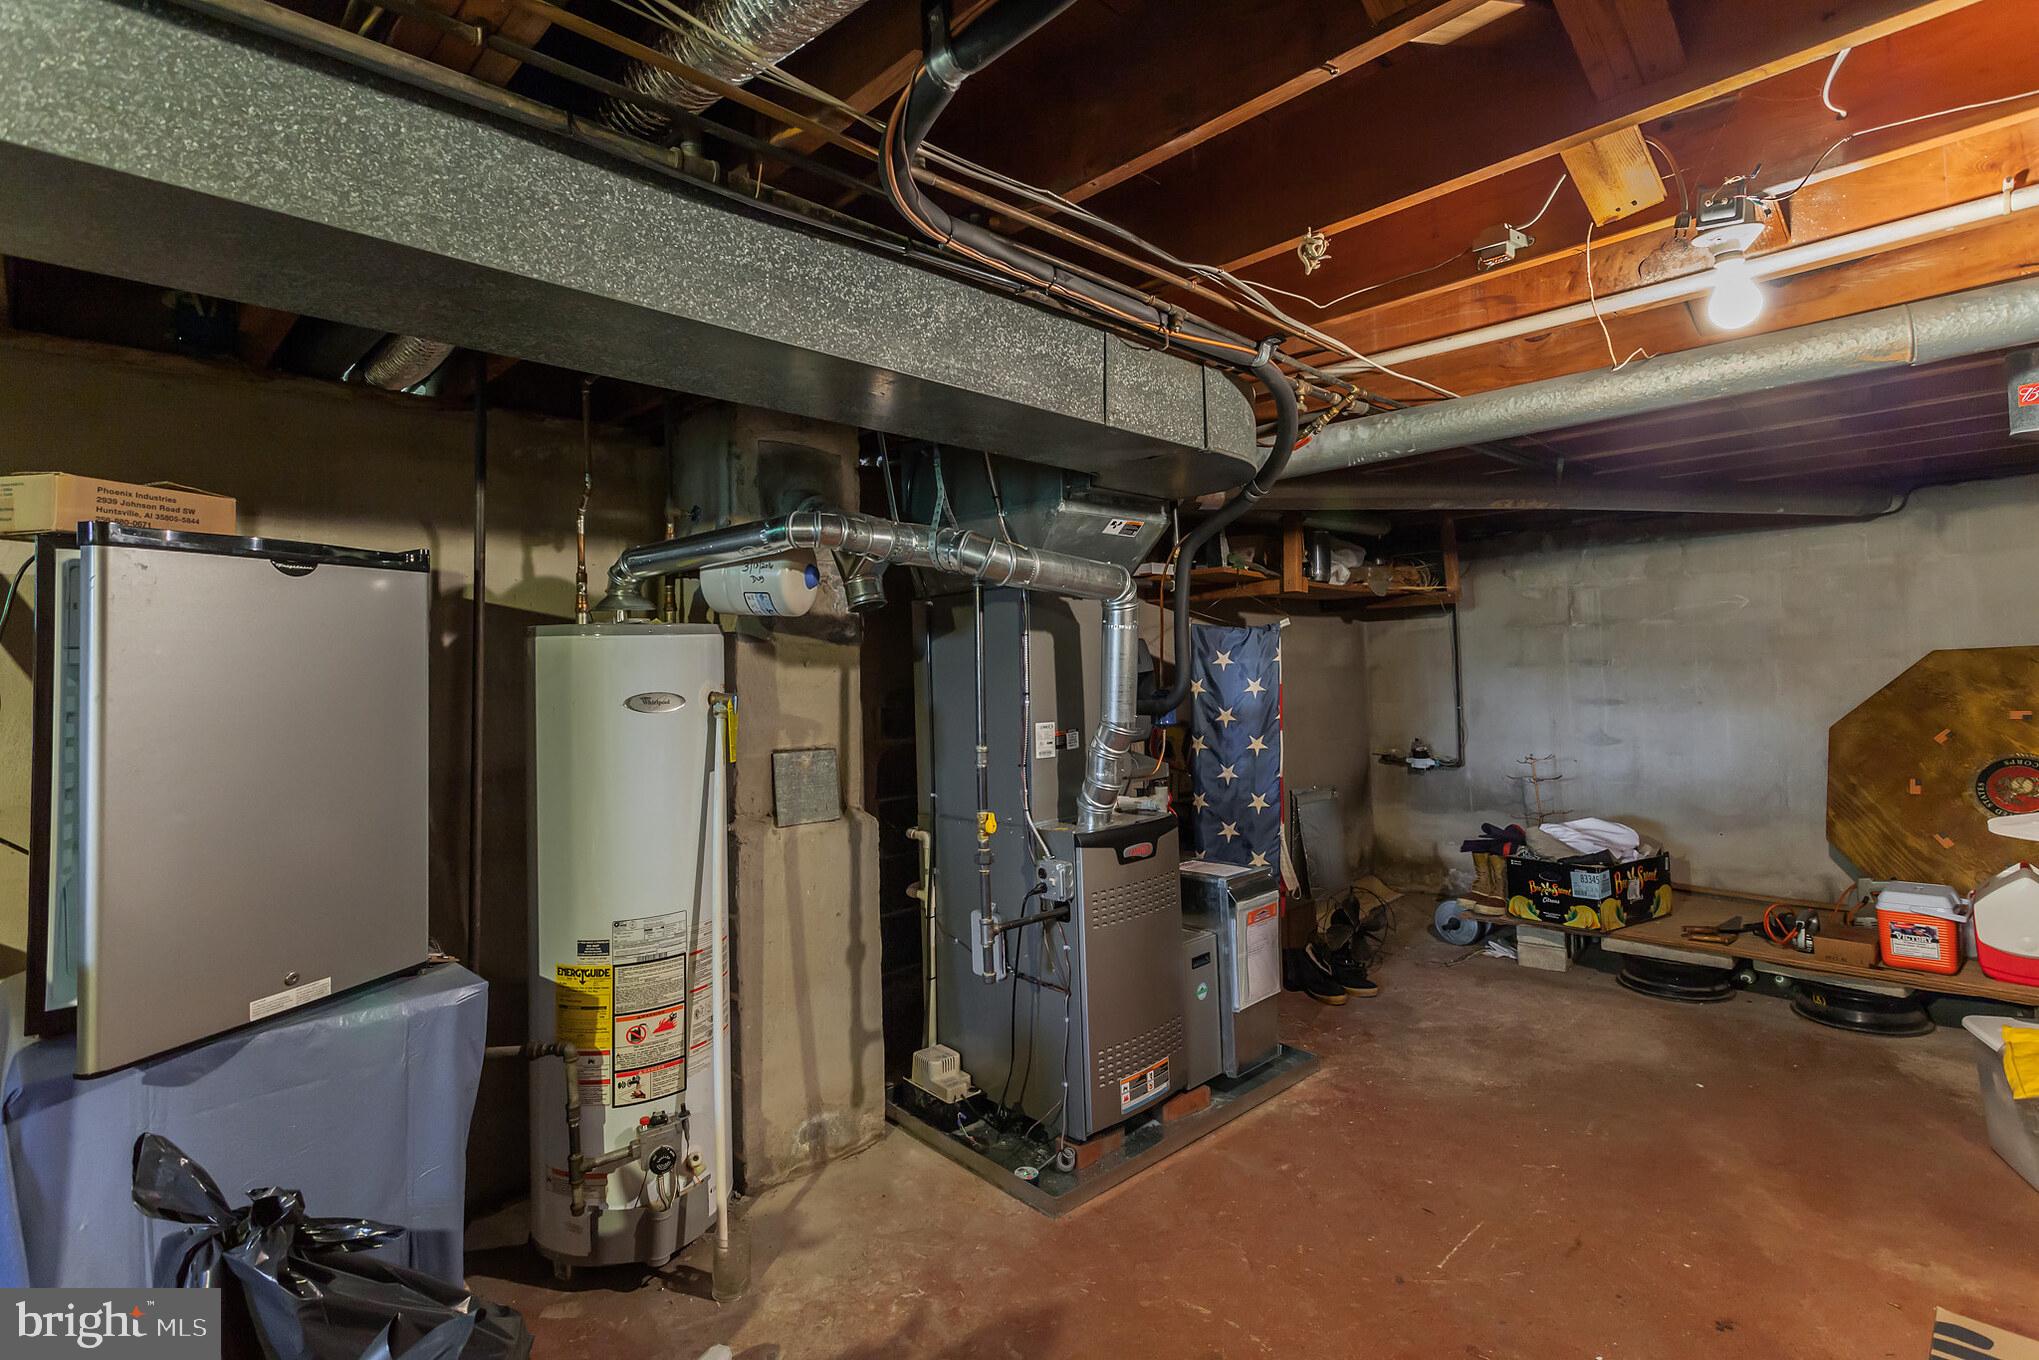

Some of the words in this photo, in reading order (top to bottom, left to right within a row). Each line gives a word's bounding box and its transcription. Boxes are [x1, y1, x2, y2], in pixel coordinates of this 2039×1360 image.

[97, 486, 132, 497] Phoenix
[135, 492, 177, 503] Industries
[96, 506, 141, 518] Huntsville,
[120, 499, 157, 511] Johnson
[159, 505, 181, 513] Road
[640, 697, 671, 706] Whirlpool
[1894, 932, 1933, 944] VICTORY
